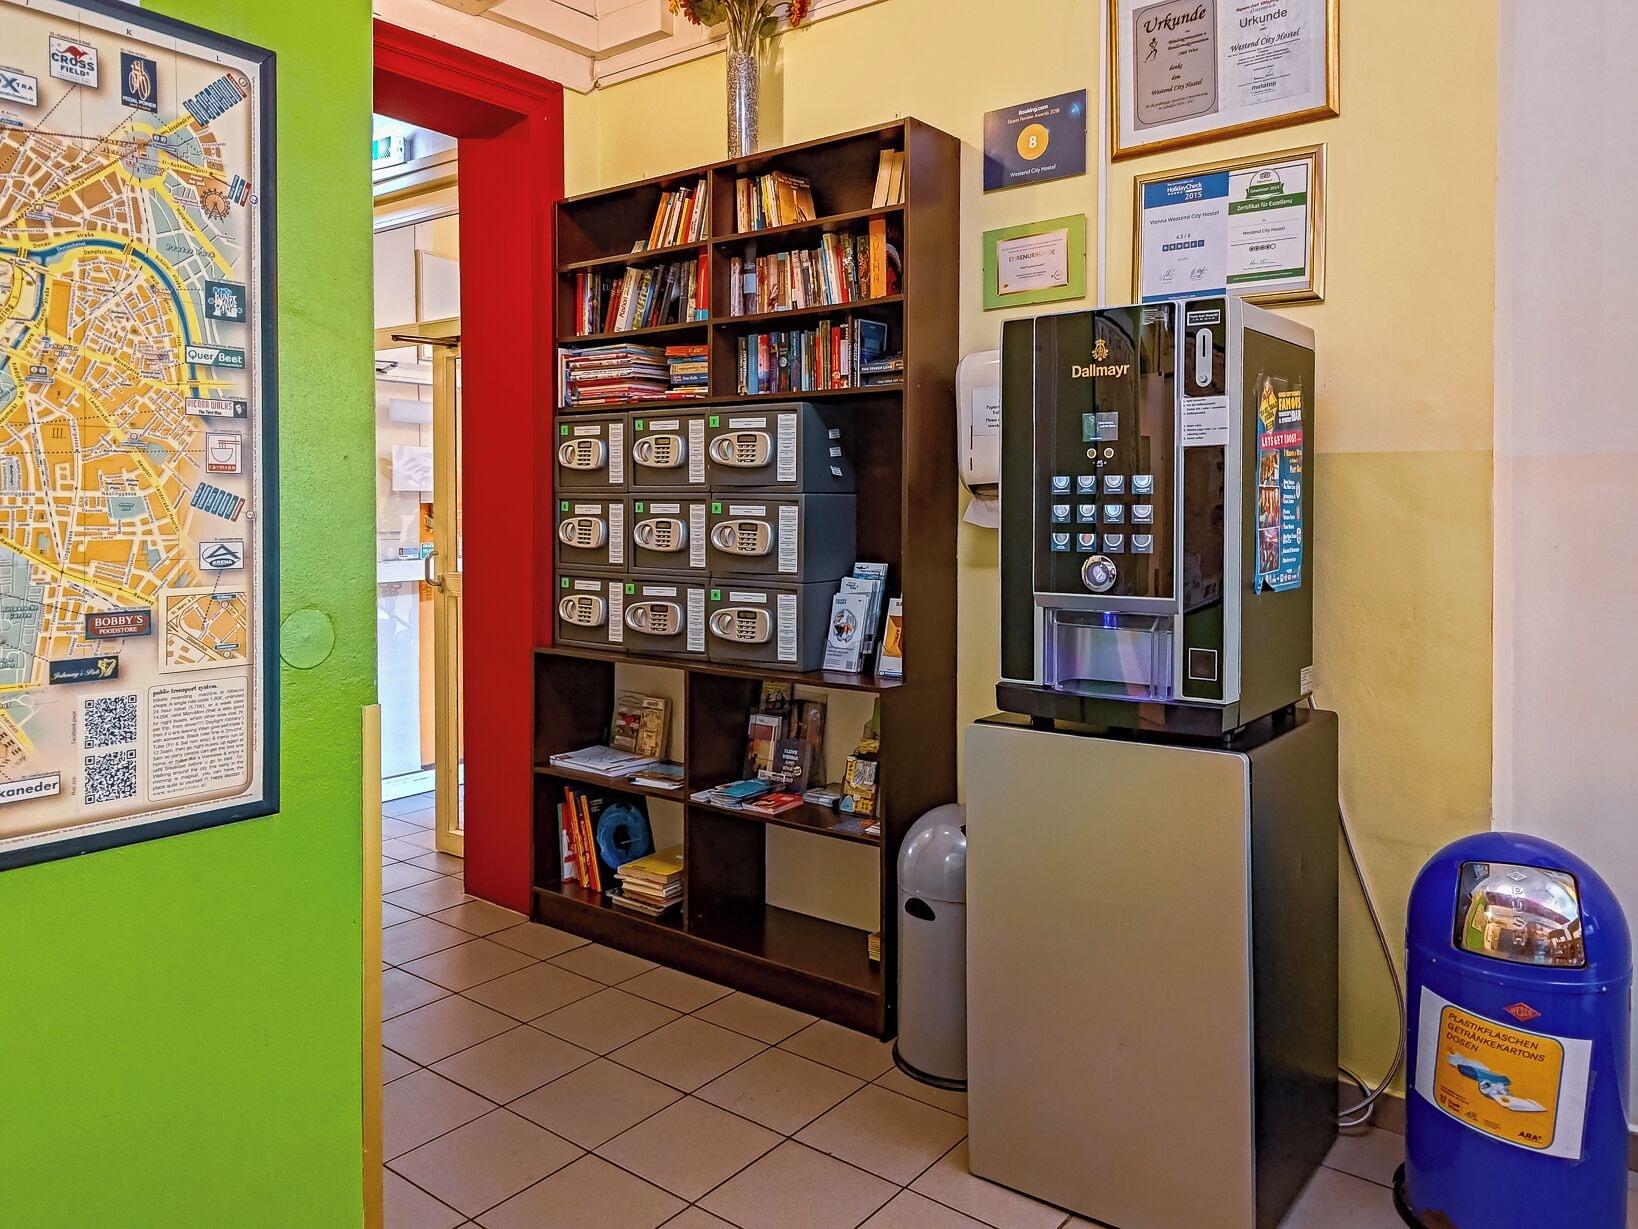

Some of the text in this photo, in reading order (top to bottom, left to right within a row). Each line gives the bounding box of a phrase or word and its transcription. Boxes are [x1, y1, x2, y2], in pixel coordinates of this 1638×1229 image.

[1144, 4, 1206, 33] Urkunde
[1240, 9, 1287, 28] Urkunde
[1230, 28, 1301, 52] Westend City Hostel
[52, 52, 95, 71] CROSS
[1018, 104, 1048, 115] Booking.com
[1028, 136, 1037, 148] 8
[1010, 169, 1030, 178] Westend
[1167, 182, 1202, 192] HolidayCheck
[1185, 192, 1202, 200] 2015
[1237, 203, 1260, 211] Zertifikat
[1168, 214, 1190, 222] Westend
[188, 350, 242, 364] Quer Beet
[1072, 363, 1129, 378] Dallmayr
[210, 400, 232, 410] WALKS
[95, 615, 144, 627] BOBBY'S
[1448, 1012, 1540, 1050] PLASTIKFLASCHEN
[1446, 1032, 1479, 1052] DOSEN
[1447, 1023, 1546, 1062] GETRÄNKEKARTONS
